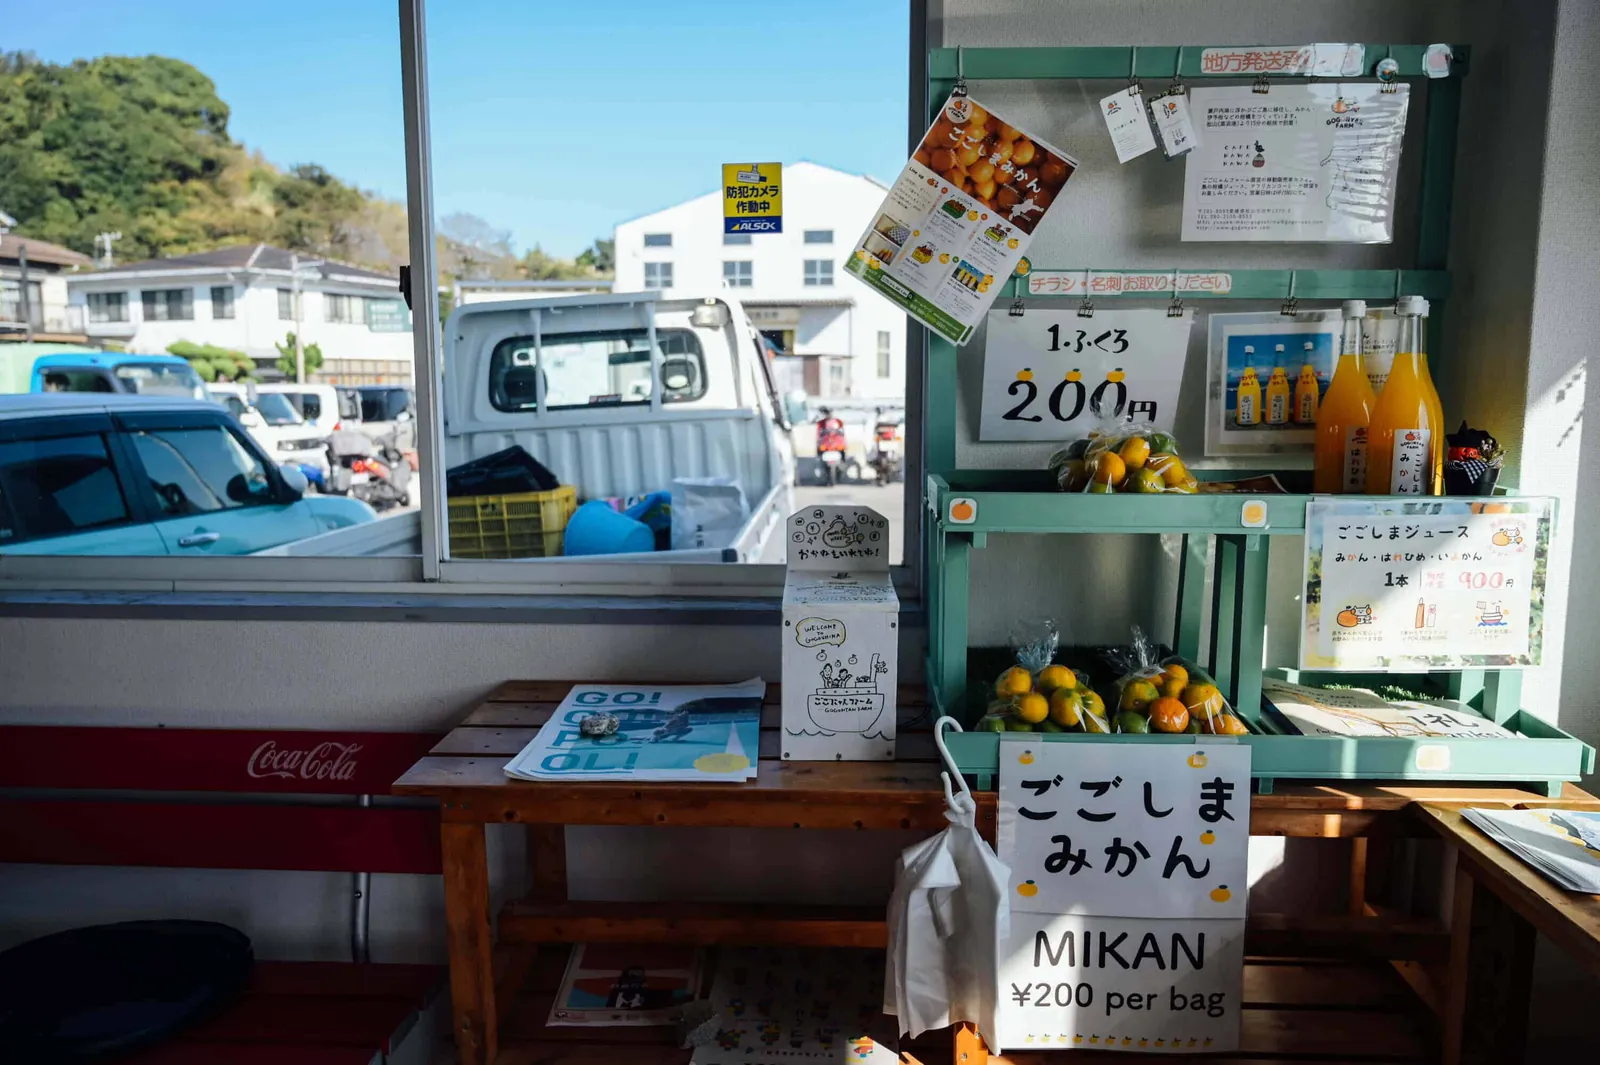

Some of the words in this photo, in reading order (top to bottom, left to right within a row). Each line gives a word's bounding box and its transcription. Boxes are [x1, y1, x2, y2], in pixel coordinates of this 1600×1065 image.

[949, 126, 1041, 193] ごごしまみかん
[726, 185, 779, 199] 防犯カメラ
[736, 200, 771, 214] 作動中
[739, 222, 777, 231] ALSOK
[1001, 379, 1158, 423] 200円
[1397, 453, 1410, 493] みかん
[1412, 453, 1424, 493] ごごしま
[1337, 524, 1470, 540] ごごしまジュース
[1335, 552, 1484, 563] みかん・はれひめ・いよかん
[1384, 571, 1410, 588] 1本
[575, 691, 663, 705] GO!
[540, 752, 639, 771] OL!
[1017, 774, 1236, 823] ごごしま
[1044, 834, 1211, 879] みかん
[1033, 930, 1205, 970] MIKAN
[1011, 982, 1094, 1008] ¥200
[1105, 990, 1158, 1017] per
[1169, 985, 1226, 1018] bag
